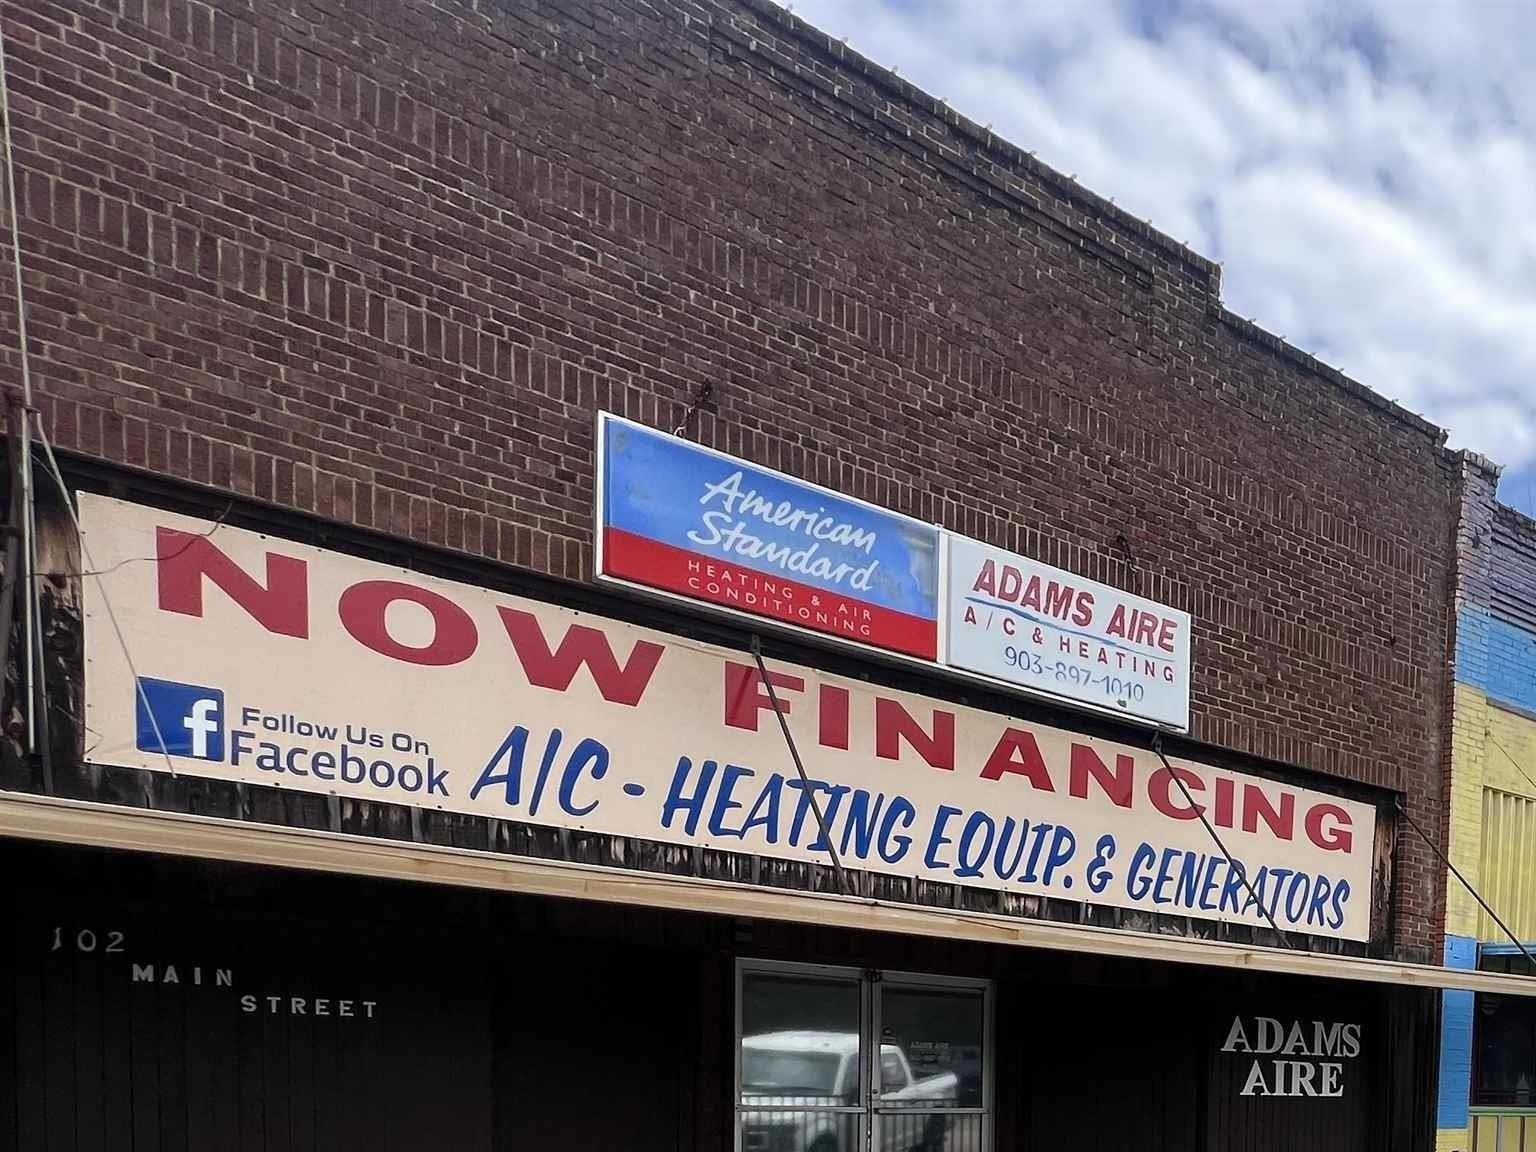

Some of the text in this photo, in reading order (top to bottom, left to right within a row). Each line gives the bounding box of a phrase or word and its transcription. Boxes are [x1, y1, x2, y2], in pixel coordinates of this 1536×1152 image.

[700, 471, 876, 554] American
[686, 511, 879, 591] Standard
[688, 560, 872, 620] HEATING & AIR
[688, 577, 871, 635] CONDITIONING
[972, 559, 1177, 652] ADAMS AIRE
[964, 606, 1174, 683] A/C & HEATING
[1004, 646, 1144, 701] 903-897-1010
[156, 526, 1353, 854] NOW FINANCING
[242, 707, 430, 756] Follow Us On
[231, 730, 451, 797] Facebook
[470, 726, 609, 817] A/C
[660, 755, 916, 866] HEATING
[925, 806, 1077, 891] EQUIP.
[1087, 837, 1115, 893] &
[1126, 841, 1350, 929] GENERATORS
[52, 927, 125, 952] 102
[132, 963, 232, 987] MAIN
[240, 995, 377, 1018] STREET
[1220, 1015, 1361, 1058] ADAMS
[1240, 1060, 1344, 1097] AIRE
